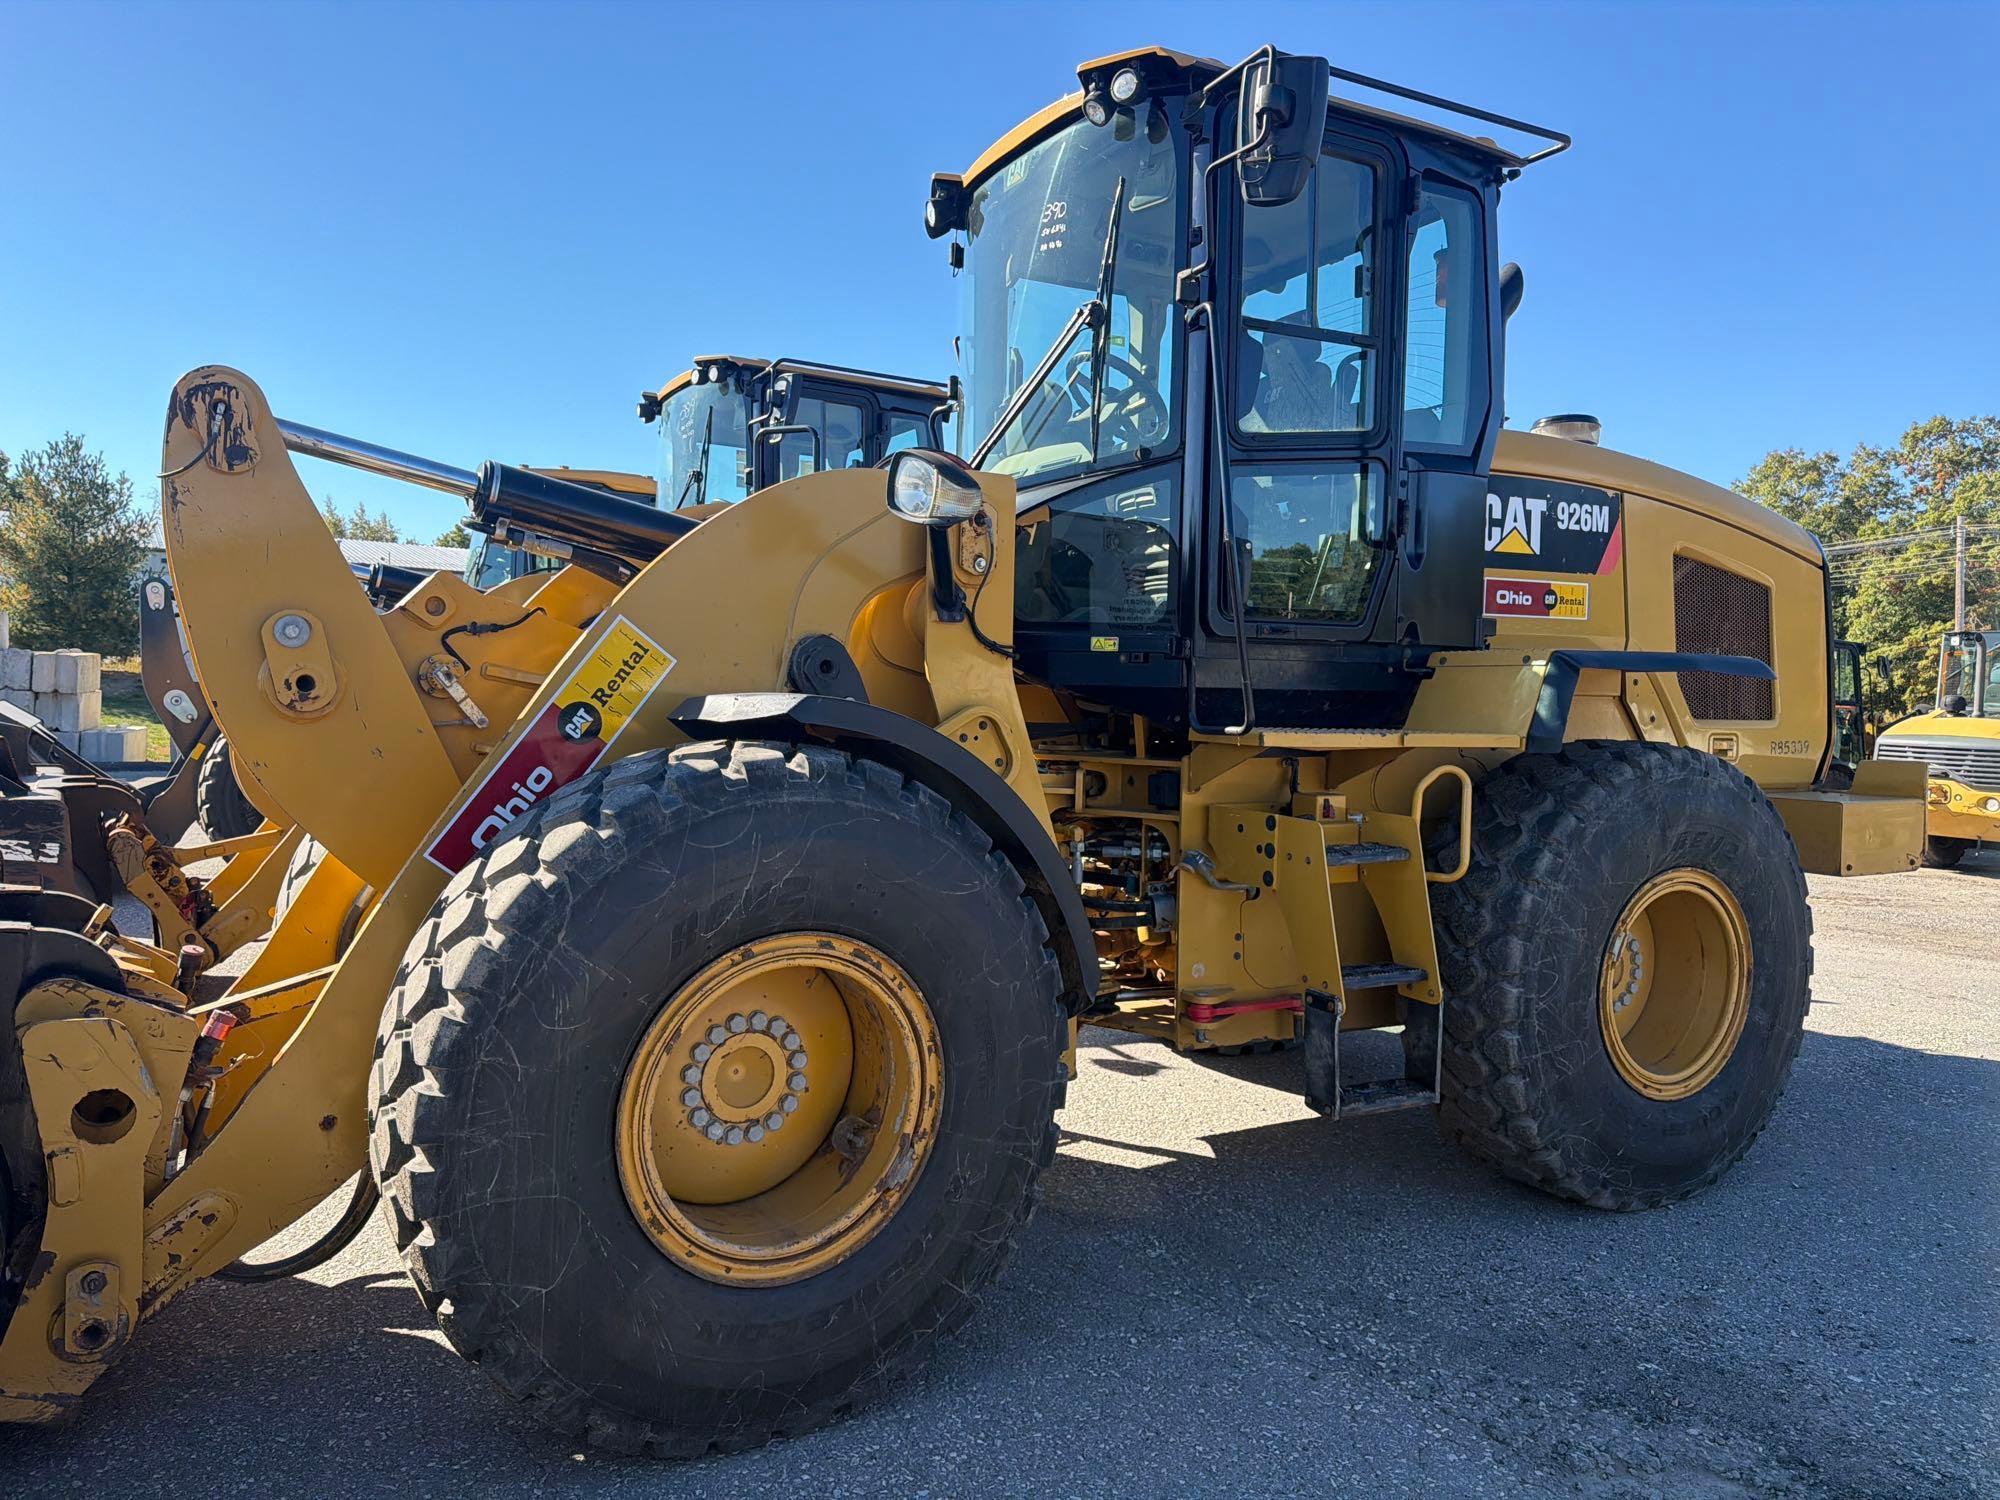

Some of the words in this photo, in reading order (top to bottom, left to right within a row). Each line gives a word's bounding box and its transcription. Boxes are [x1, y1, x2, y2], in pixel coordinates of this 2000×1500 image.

[1006, 156, 1028, 187] CAT
[1042, 202, 1067, 223] 390
[1485, 493, 1547, 555] CAT
[1557, 502, 1609, 533] 926M
[1496, 590, 1532, 606] Ohio
[1545, 595, 1556, 605] CAT
[1559, 596, 1584, 606] Rental
[575, 629, 634, 695] THE
[608, 653, 665, 718] STORE
[470, 765, 553, 850] Ohio
[565, 707, 593, 739] CAT
[590, 641, 650, 708] Rental
